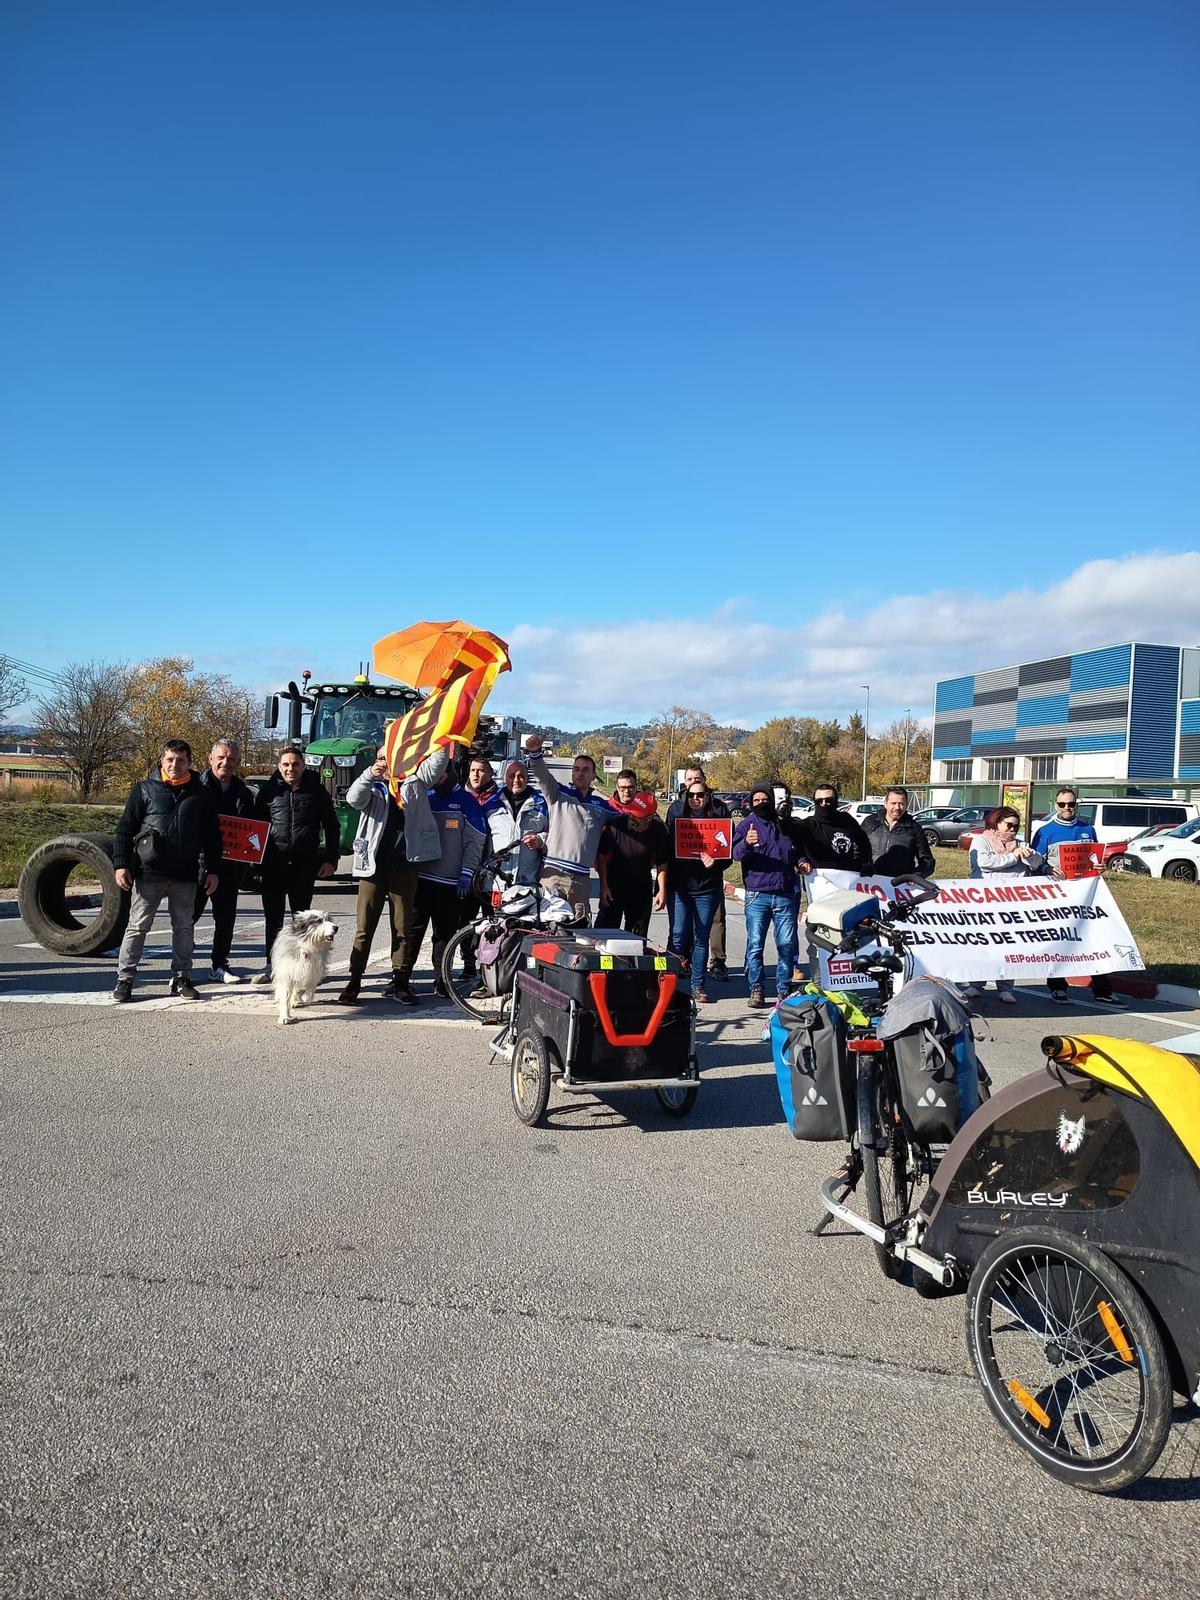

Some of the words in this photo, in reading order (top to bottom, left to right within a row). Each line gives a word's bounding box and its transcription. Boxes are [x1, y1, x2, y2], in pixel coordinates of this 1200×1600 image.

[219, 819, 252, 830] ARELLI
[680, 832, 694, 840] NO
[926, 884, 1067, 904] ANCAMENT!
[900, 909, 996, 925] ONTINUÏTAT
[998, 911, 1021, 925] DE
[1024, 905, 1109, 923] L'EMPRESA
[889, 930, 936, 946] ELS
[936, 932, 989, 946] LLOCS
[989, 931, 1016, 945] DE
[1015, 926, 1083, 943] TREBALL
[830, 974, 874, 985] indústria
[967, 1190, 1067, 1208] BURLEY
